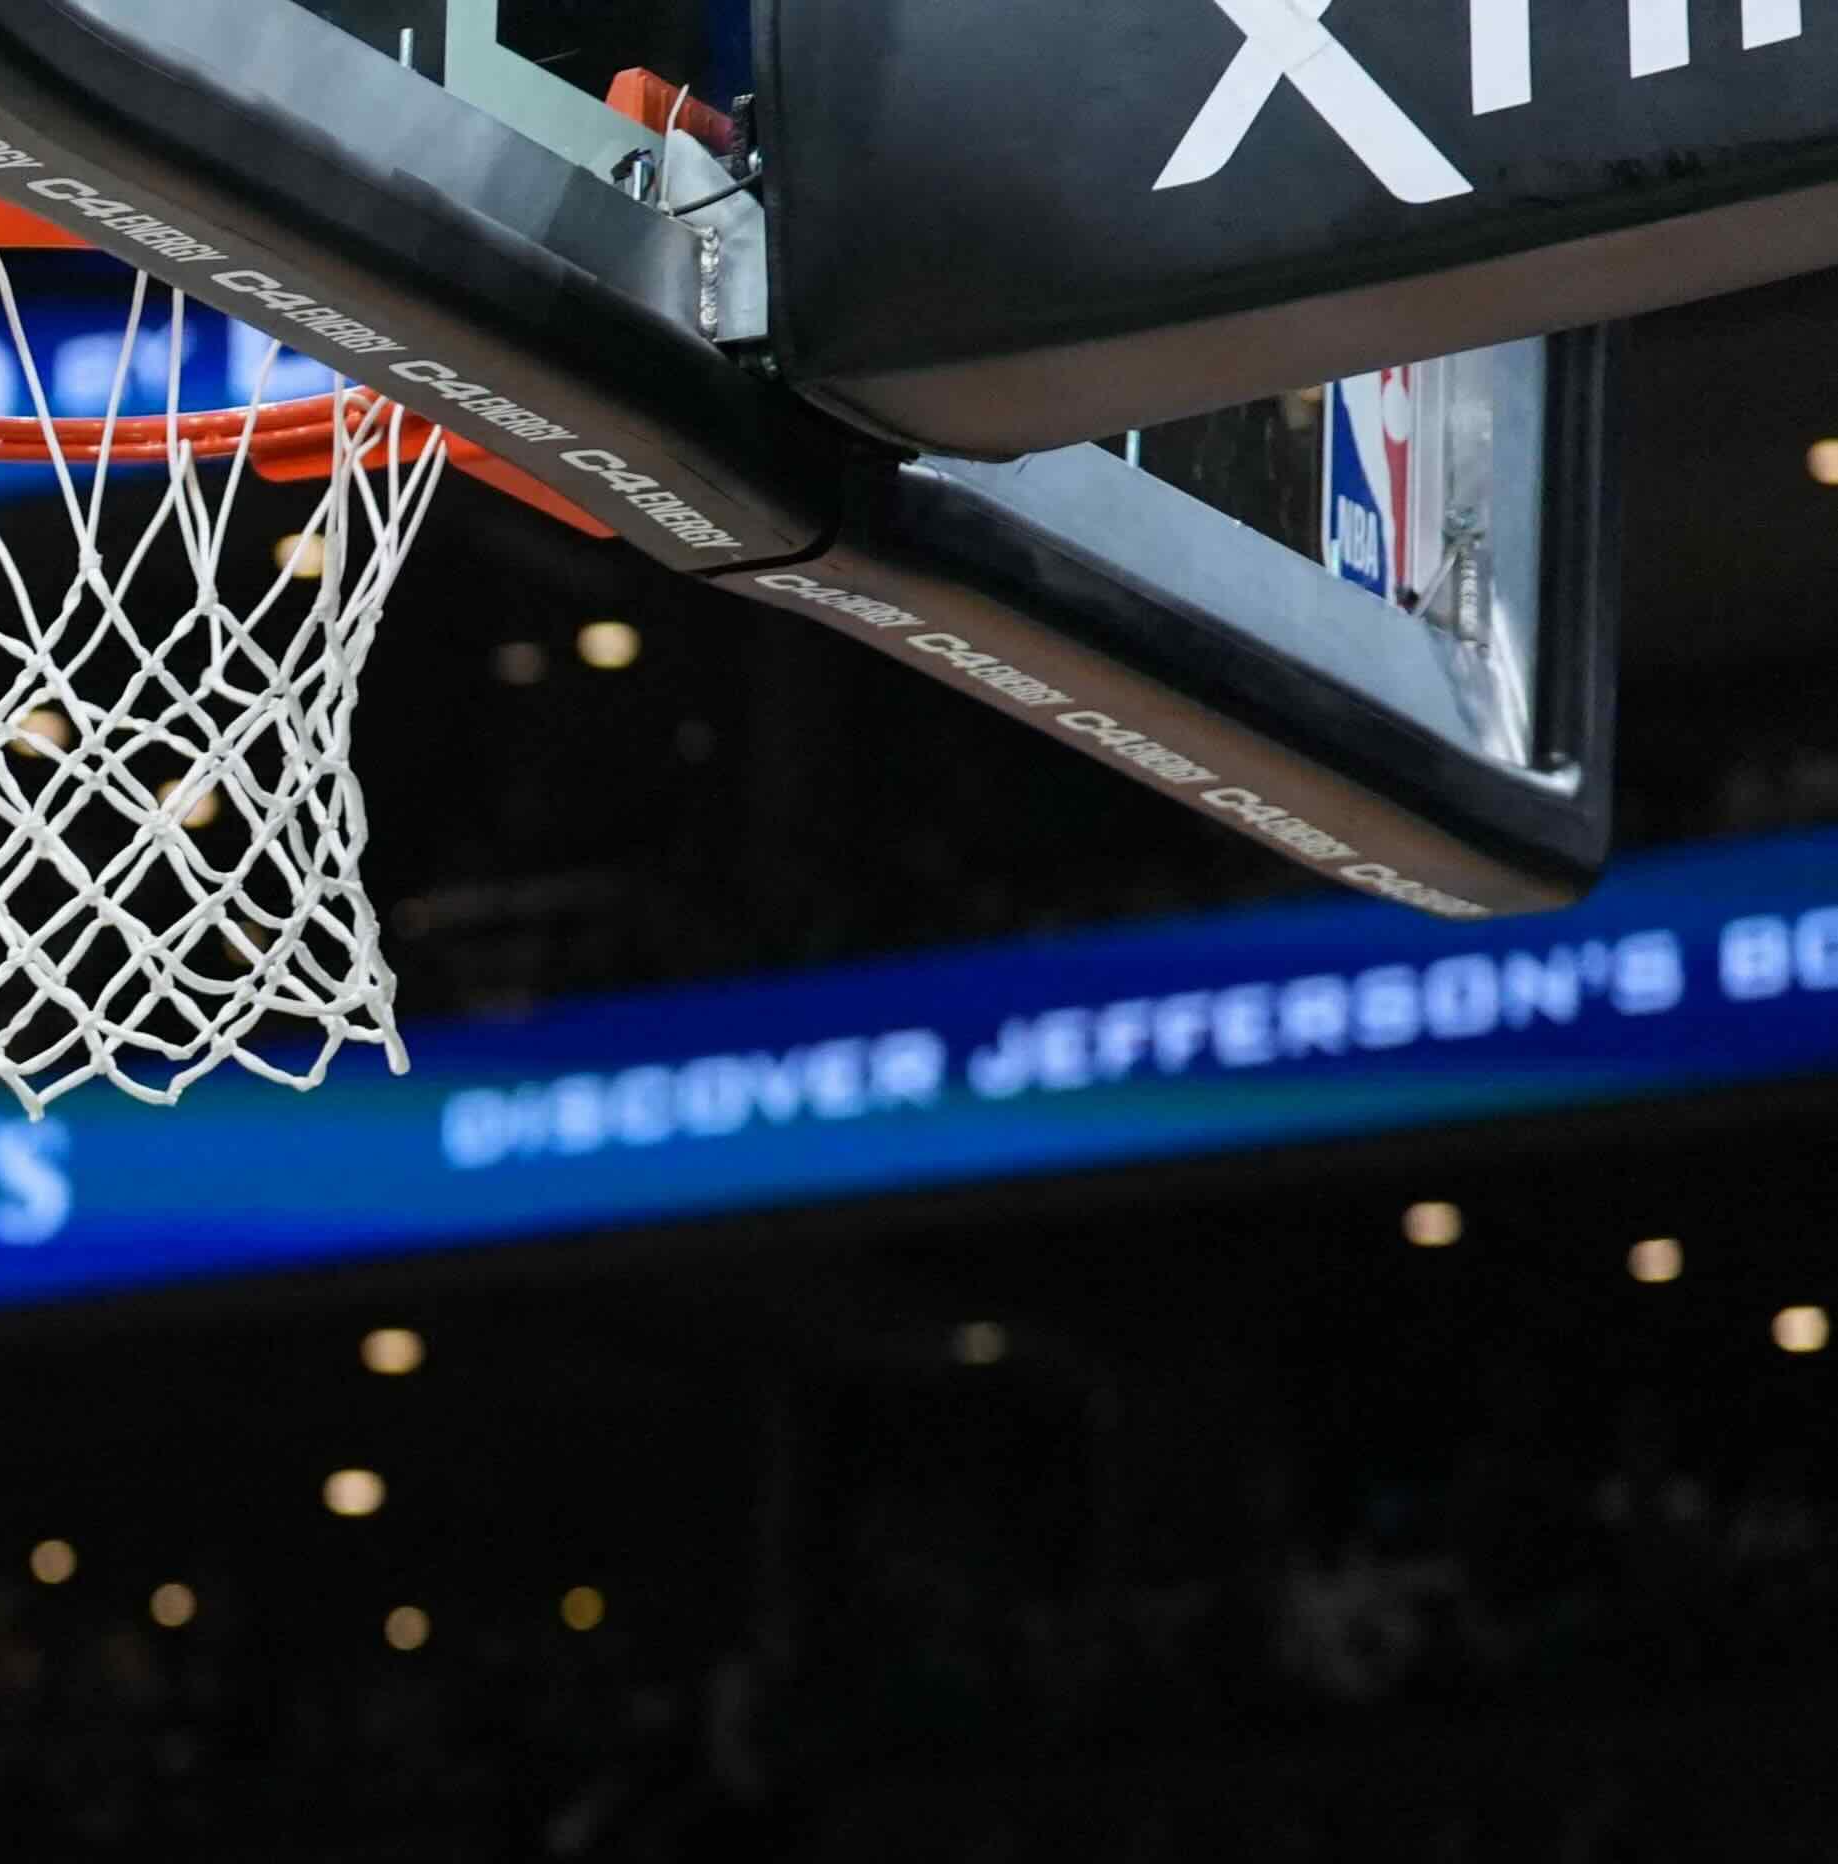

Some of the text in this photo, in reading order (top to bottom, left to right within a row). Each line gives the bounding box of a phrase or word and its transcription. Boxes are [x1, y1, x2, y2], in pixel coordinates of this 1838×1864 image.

[27, 177, 229, 263] C4 ENERGY
[211, 269, 409, 354] C4 ENERGY
[388, 359, 580, 443] C4 ENERGY
[559, 448, 744, 548] C4 ENERGY
[1336, 494, 1381, 581] NBA
[441, 1026, 947, 1171] DISCOVER
[967, 928, 1684, 1100] JEFFERSON'S
